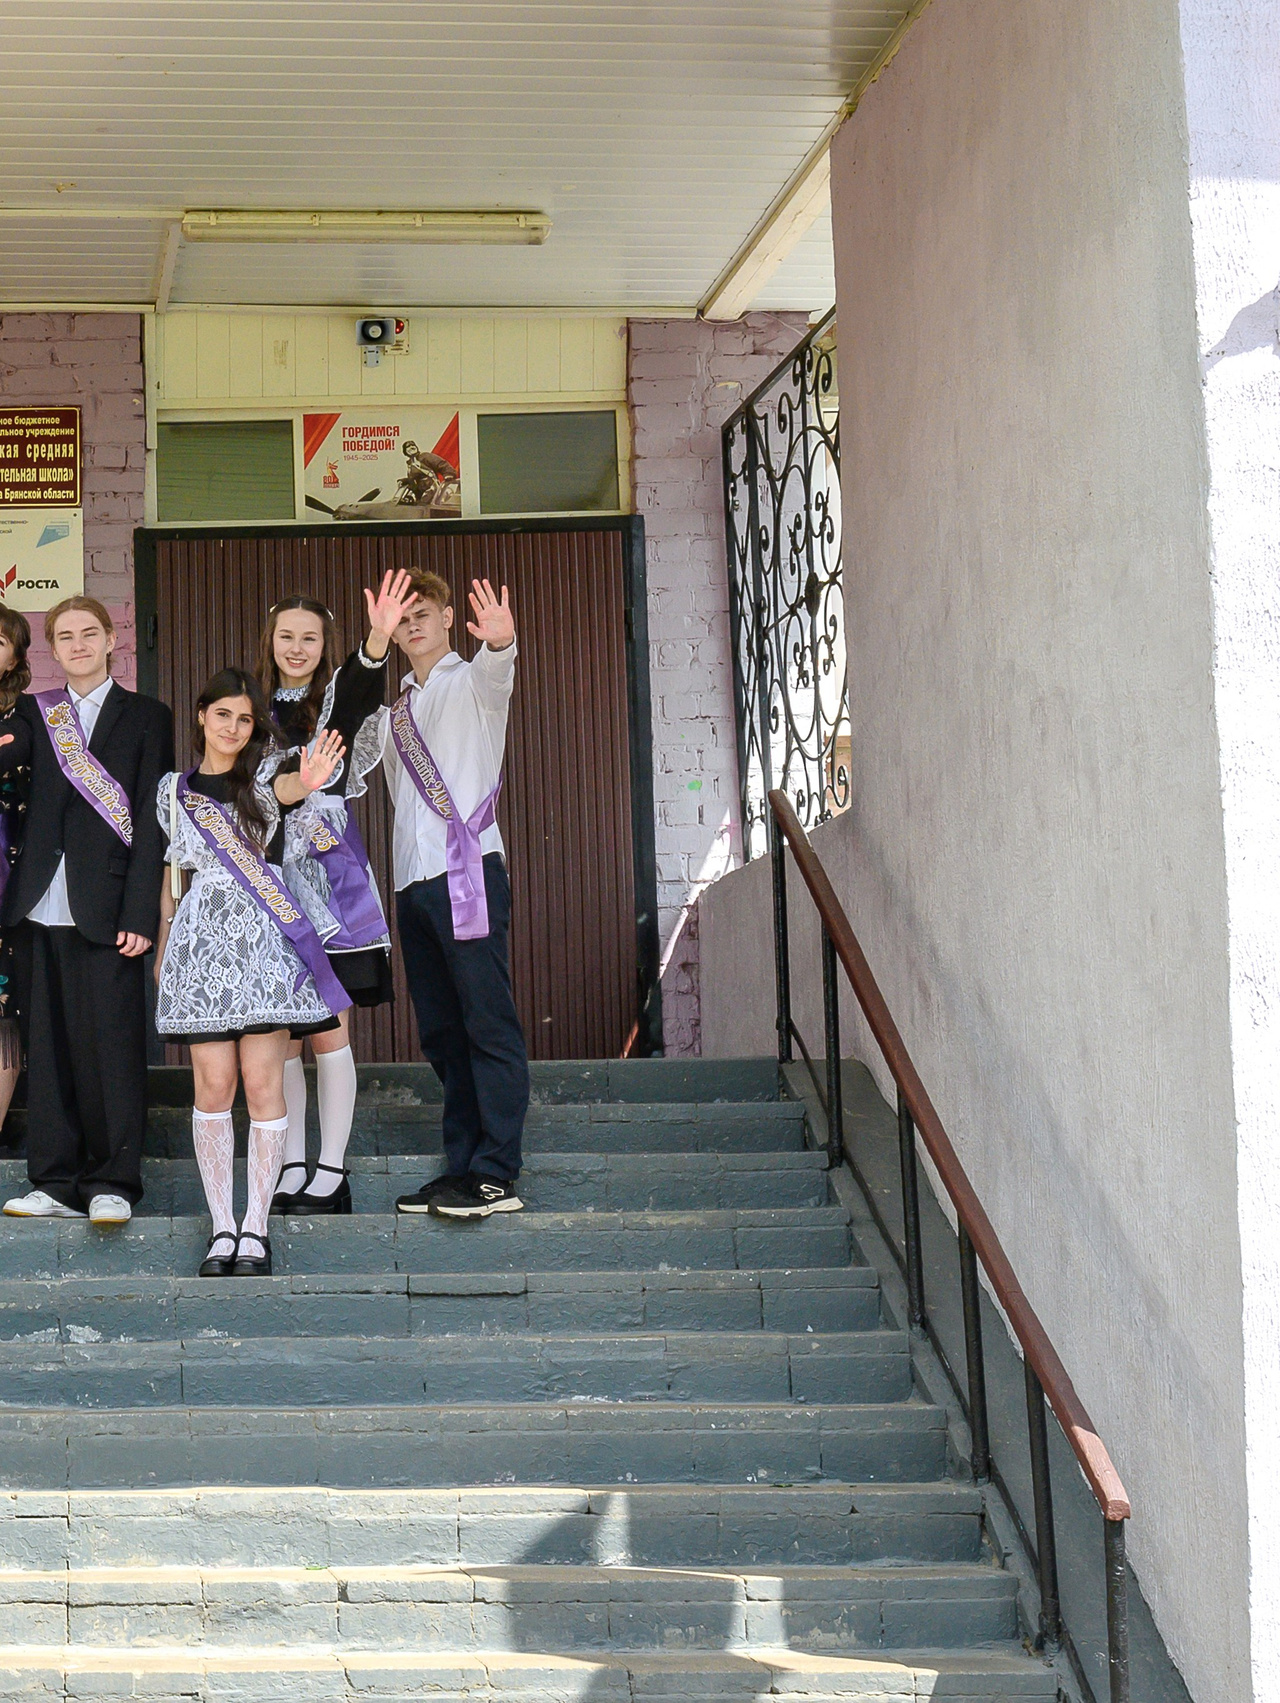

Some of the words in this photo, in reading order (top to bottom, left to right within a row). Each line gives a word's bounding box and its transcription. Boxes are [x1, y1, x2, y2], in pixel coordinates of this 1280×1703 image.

[14, 416, 60, 426] бюджетное
[26, 427, 74, 438] учреждение
[342, 426, 400, 439] ГОРДИМСЯ
[342, 439, 395, 452] ПОБЕДОЙ!
[26, 443, 74, 462] средняя
[38, 466, 74, 482] школа»
[4, 487, 41, 501] Брянской
[43, 487, 74, 499] области
[16, 579, 59, 589] РОСТА
[54, 725, 120, 811] Выпускник
[110, 806, 134, 843] 202
[257, 884, 301, 923] 2025
